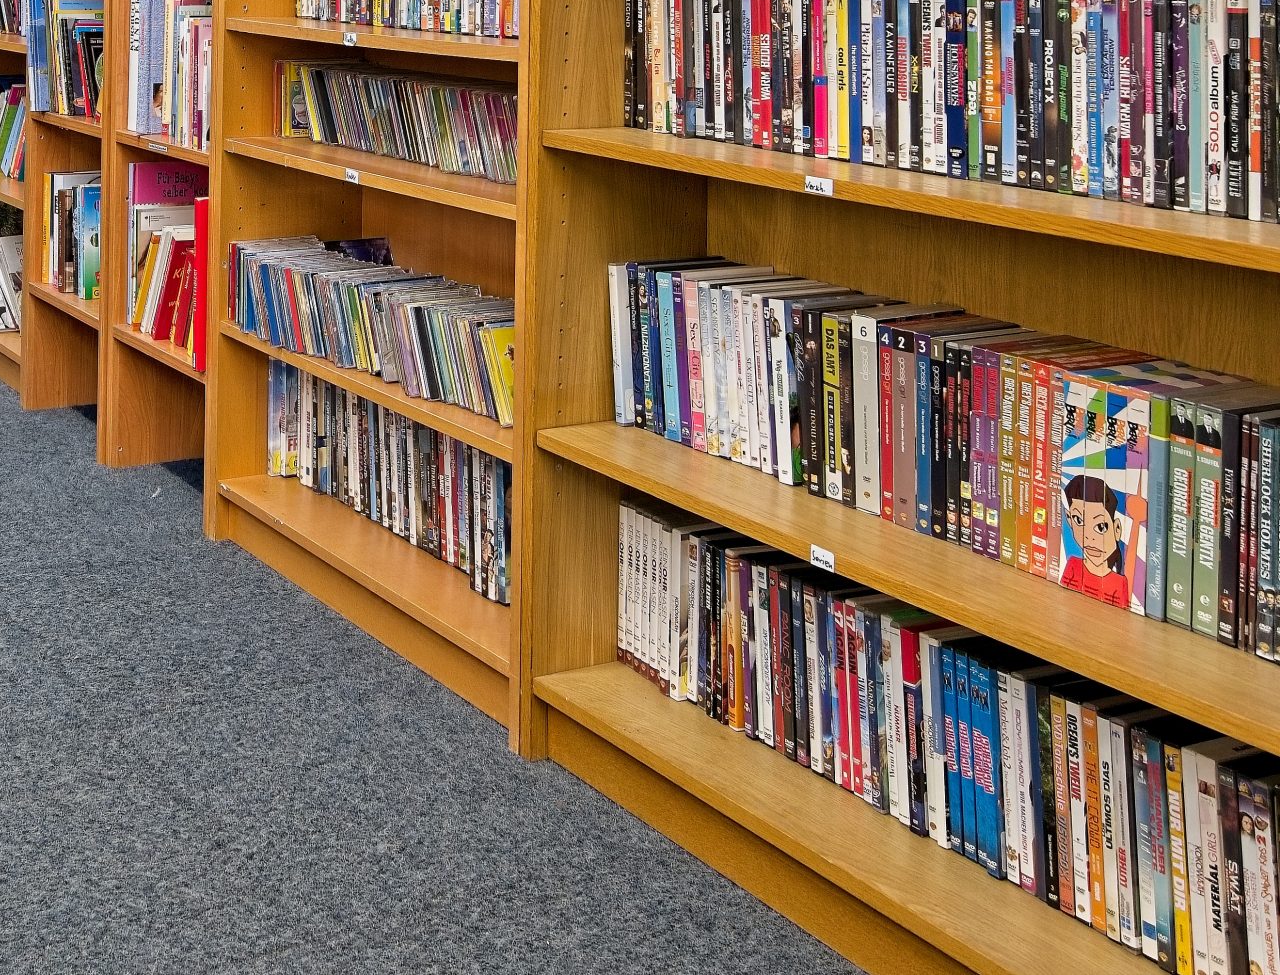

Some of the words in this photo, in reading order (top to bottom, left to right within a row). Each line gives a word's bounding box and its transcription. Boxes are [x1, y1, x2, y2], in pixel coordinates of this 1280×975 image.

[760, 34, 770, 68] BODIES
[923, 33, 931, 68] TWELVE
[984, 20, 992, 56] WAKING
[886, 22, 894, 93] KAMINFEUER
[897, 36, 907, 101] FRIENDSHIP!
[985, 59, 993, 75] THE
[1045, 40, 1054, 93] PROJECT
[761, 72, 771, 100] WARM
[950, 43, 959, 106] HOUSEWIVES
[1074, 76, 1081, 88] da
[985, 79, 994, 102] DEAD
[1045, 94, 1053, 103] X
[1074, 105, 1084, 141] Solange
[162, 185, 188, 198] selber
[192, 185, 208, 198] koc
[663, 308, 671, 329] Sex
[689, 322, 698, 341] Sex
[860, 326, 867, 338] 6
[664, 337, 673, 359] City
[826, 328, 835, 352] DAS
[881, 333, 890, 343] 4
[898, 336, 905, 348] 2
[918, 341, 926, 353] 3
[690, 356, 700, 378] City
[826, 355, 836, 376] AMT
[882, 352, 890, 379] gossip
[918, 361, 926, 390] gossip
[1003, 377, 1015, 400] GREY'S
[1021, 382, 1033, 405] GREY'S
[1036, 386, 1047, 409] GREY'S
[1053, 392, 1064, 415] GREY'S
[1002, 400, 1013, 431] ANATOMY
[1019, 404, 1031, 436] ANATOMY
[1035, 409, 1046, 441] ANATOMY
[1051, 414, 1062, 447] ANATOMY
[1261, 437, 1272, 506] SHERLOCK
[1173, 467, 1189, 515] GEORGE
[1200, 478, 1215, 525] GEORGE
[1172, 515, 1188, 558] GENTLY
[1200, 526, 1214, 570] GENTLY
[1260, 510, 1270, 580] HOLMES
[834, 610, 843, 625] 17
[846, 614, 854, 630] 17
[781, 611, 789, 658] PANIC
[836, 630, 844, 670] AGAIN
[847, 632, 856, 674] AGAIN
[783, 664, 791, 713] ROOM
[1000, 698, 1010, 732] Marley
[1001, 734, 1010, 744] &
[1067, 715, 1079, 759] OCEAN'S
[1002, 760, 1011, 769] 2
[1086, 762, 1096, 784] THE
[1070, 760, 1081, 802] TWELVE
[1168, 790, 1182, 831] NUR
[1171, 835, 1184, 875] MIT
[1207, 832, 1217, 863] GIRLS
[1118, 848, 1128, 888] LUTHER
[1173, 877, 1187, 911] DIR
[1207, 863, 1223, 932] MATERIAL
